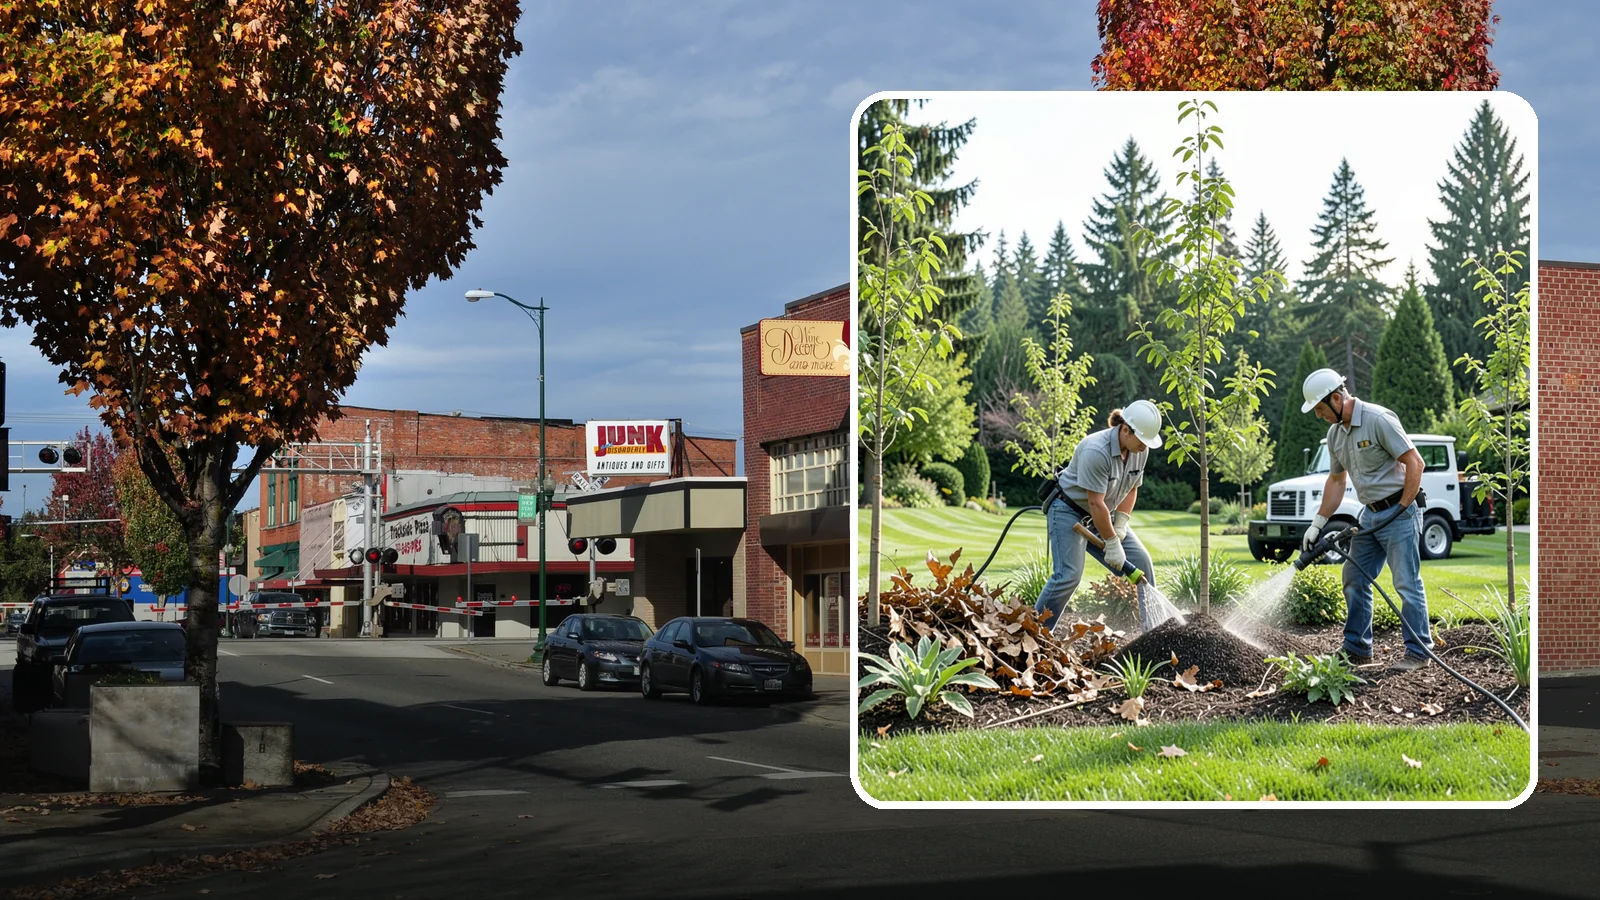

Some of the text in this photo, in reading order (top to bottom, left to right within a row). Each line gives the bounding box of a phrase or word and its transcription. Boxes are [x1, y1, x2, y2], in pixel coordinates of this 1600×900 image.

[791, 325, 823, 344] Wine
[595, 425, 665, 457] JUNK
[607, 446, 646, 454] DISORDERLY
[597, 460, 665, 470] ANTIQUES AND GIFTS
[414, 519, 429, 535] Pizza
